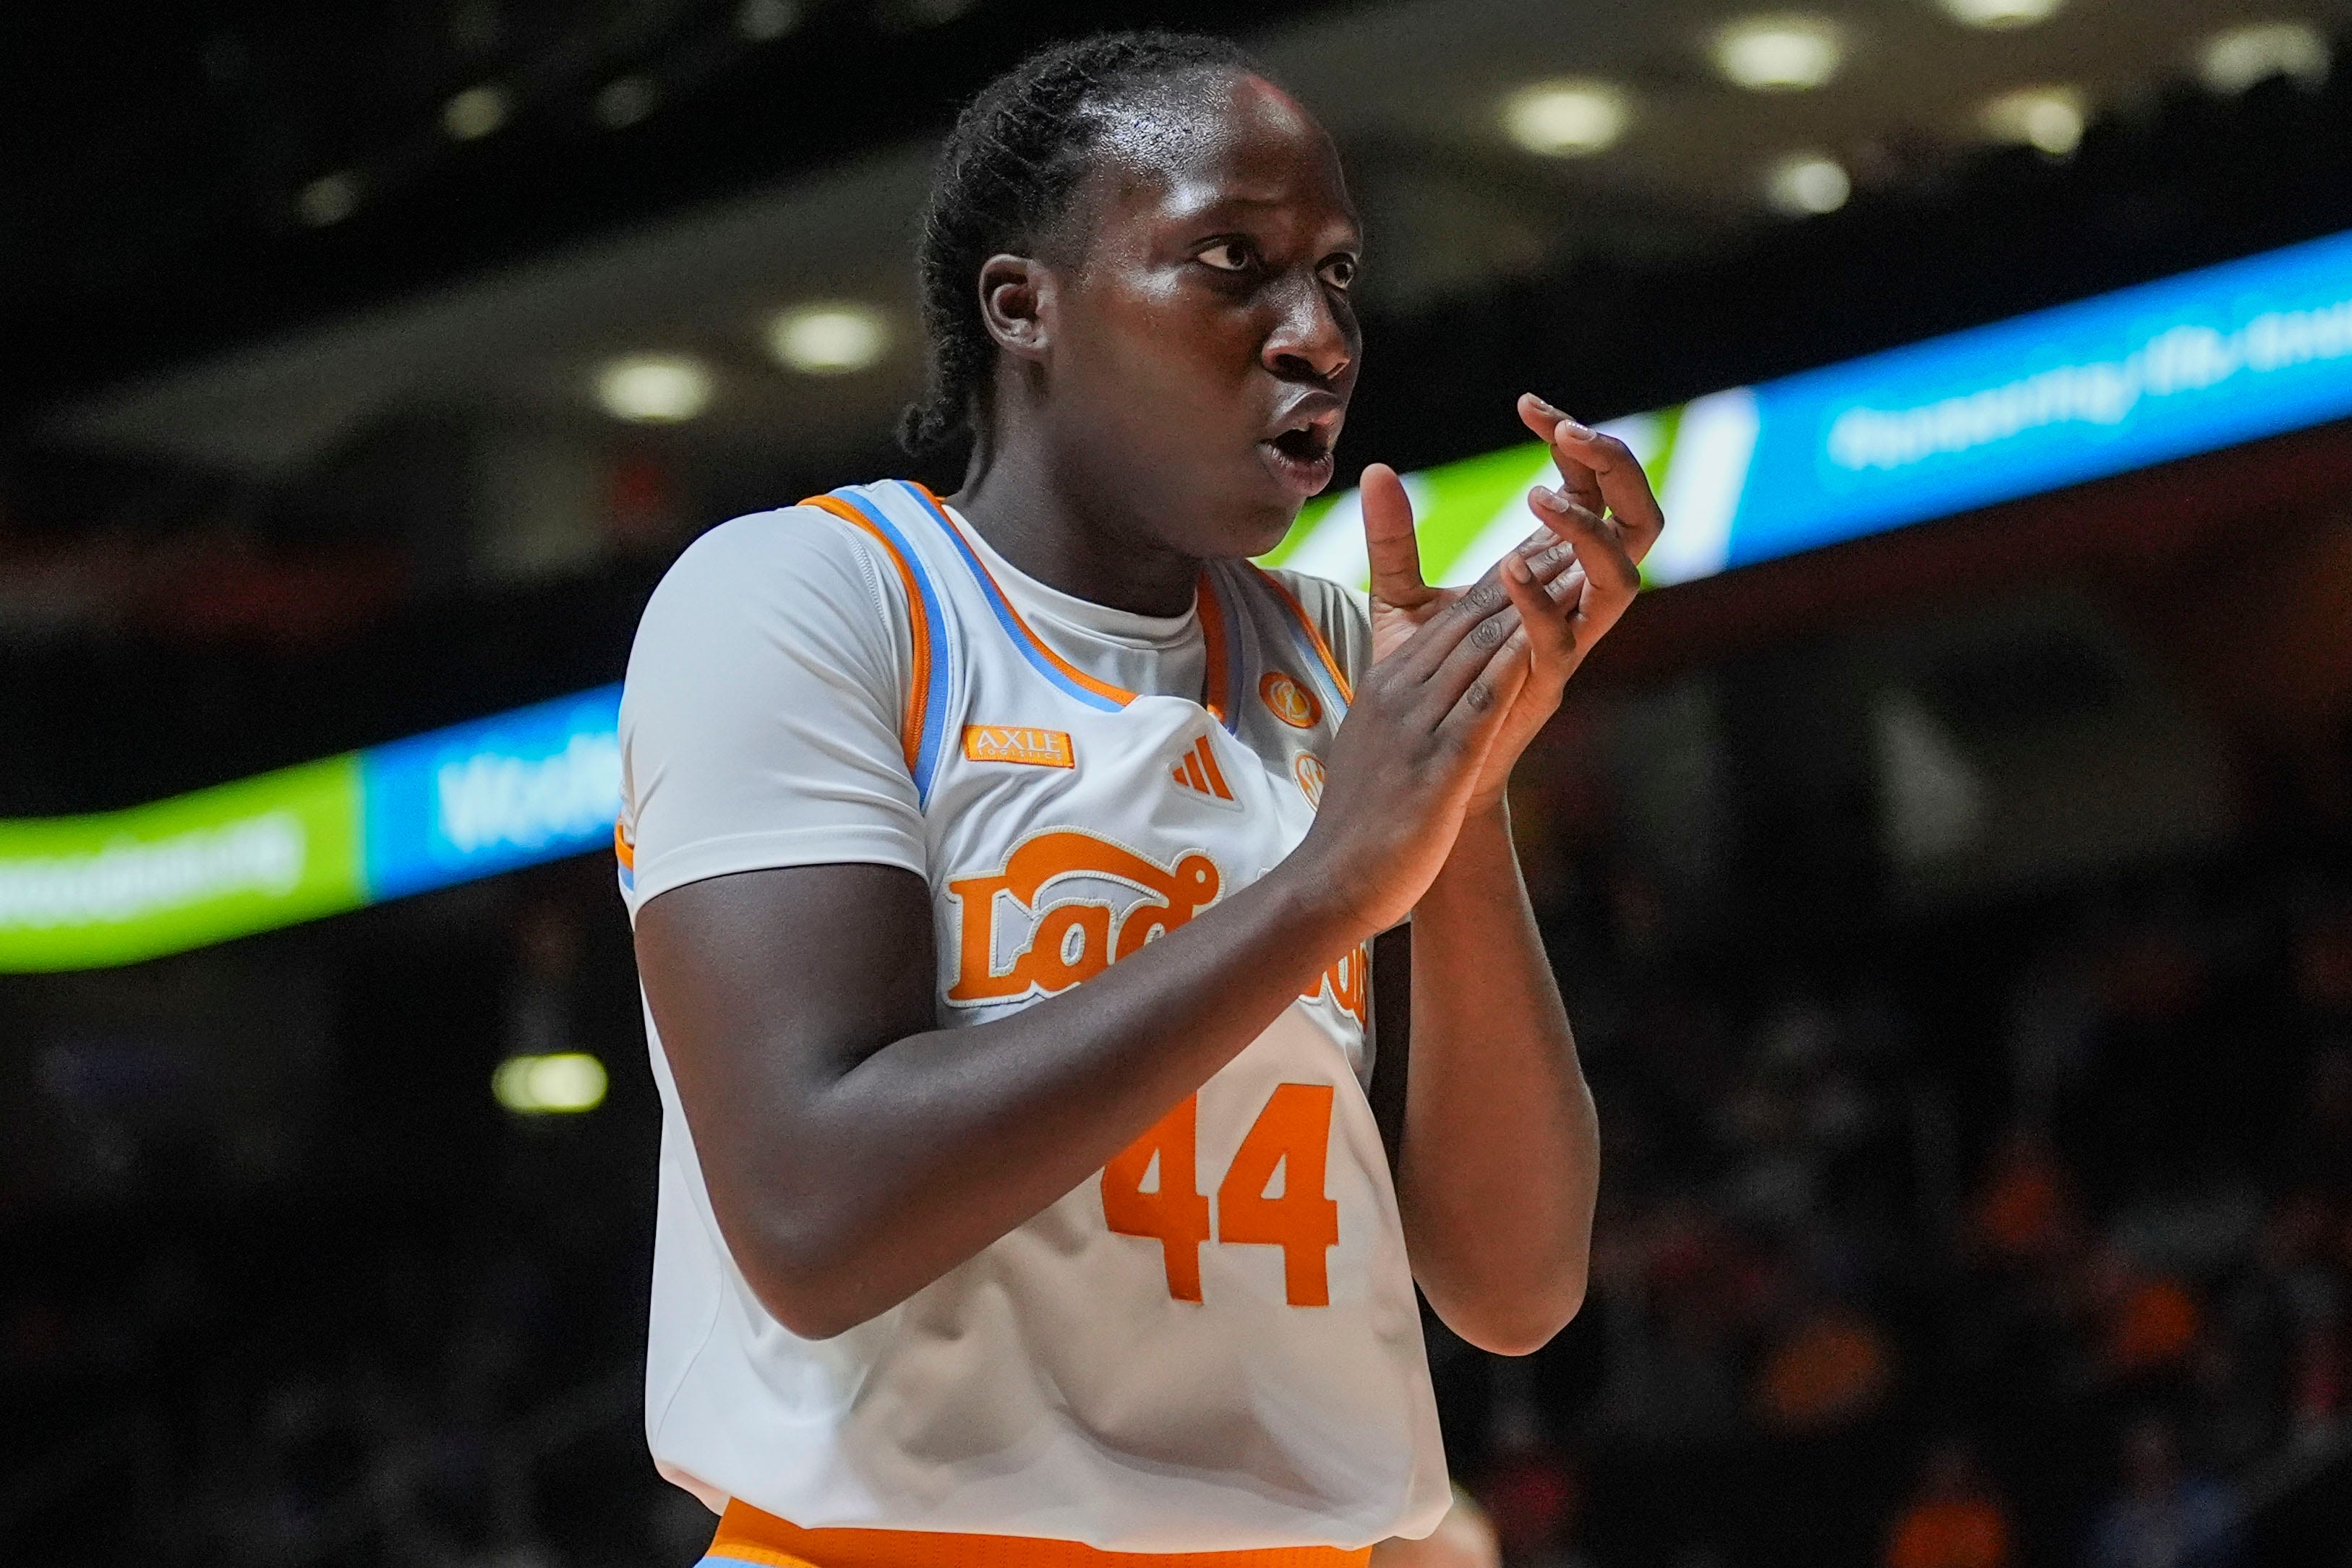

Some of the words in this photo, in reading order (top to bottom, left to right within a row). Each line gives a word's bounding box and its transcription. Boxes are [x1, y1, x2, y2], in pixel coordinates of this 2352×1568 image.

[978, 729, 1061, 753] AXLE
[943, 826, 1227, 1008] Lad
[1100, 1083, 1339, 1307] 44
